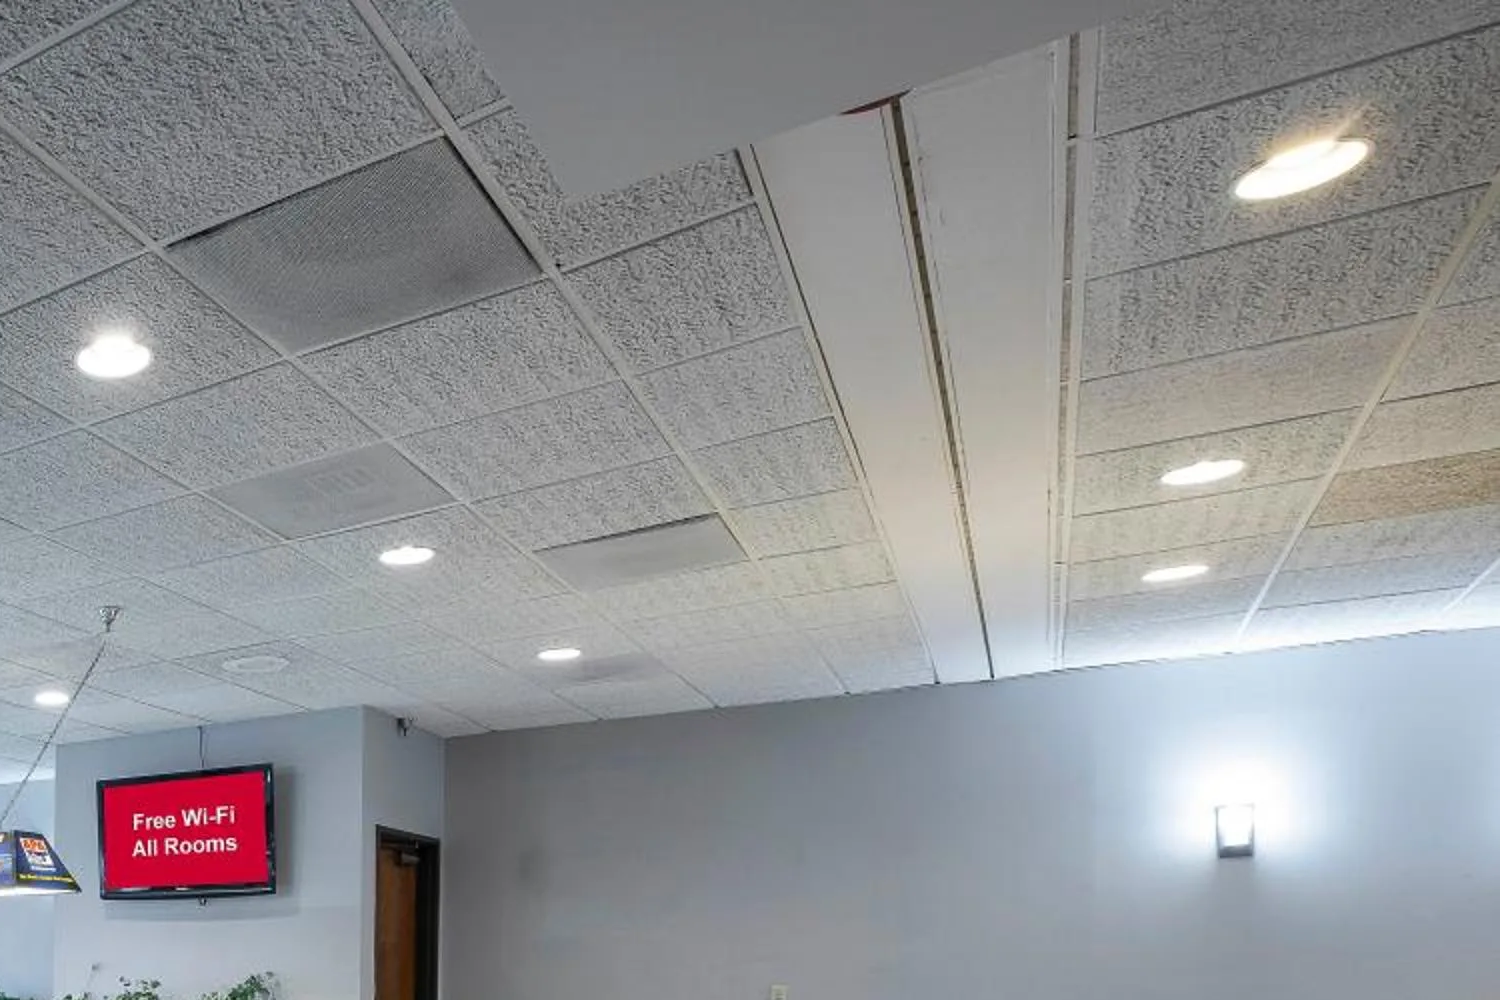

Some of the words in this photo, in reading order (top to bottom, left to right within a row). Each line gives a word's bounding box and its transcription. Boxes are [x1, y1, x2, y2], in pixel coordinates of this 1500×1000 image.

[132, 813, 177, 831] Free
[181, 805, 235, 827] Wi-Fi
[131, 838, 159, 857] All
[164, 836, 238, 856] Rooms
